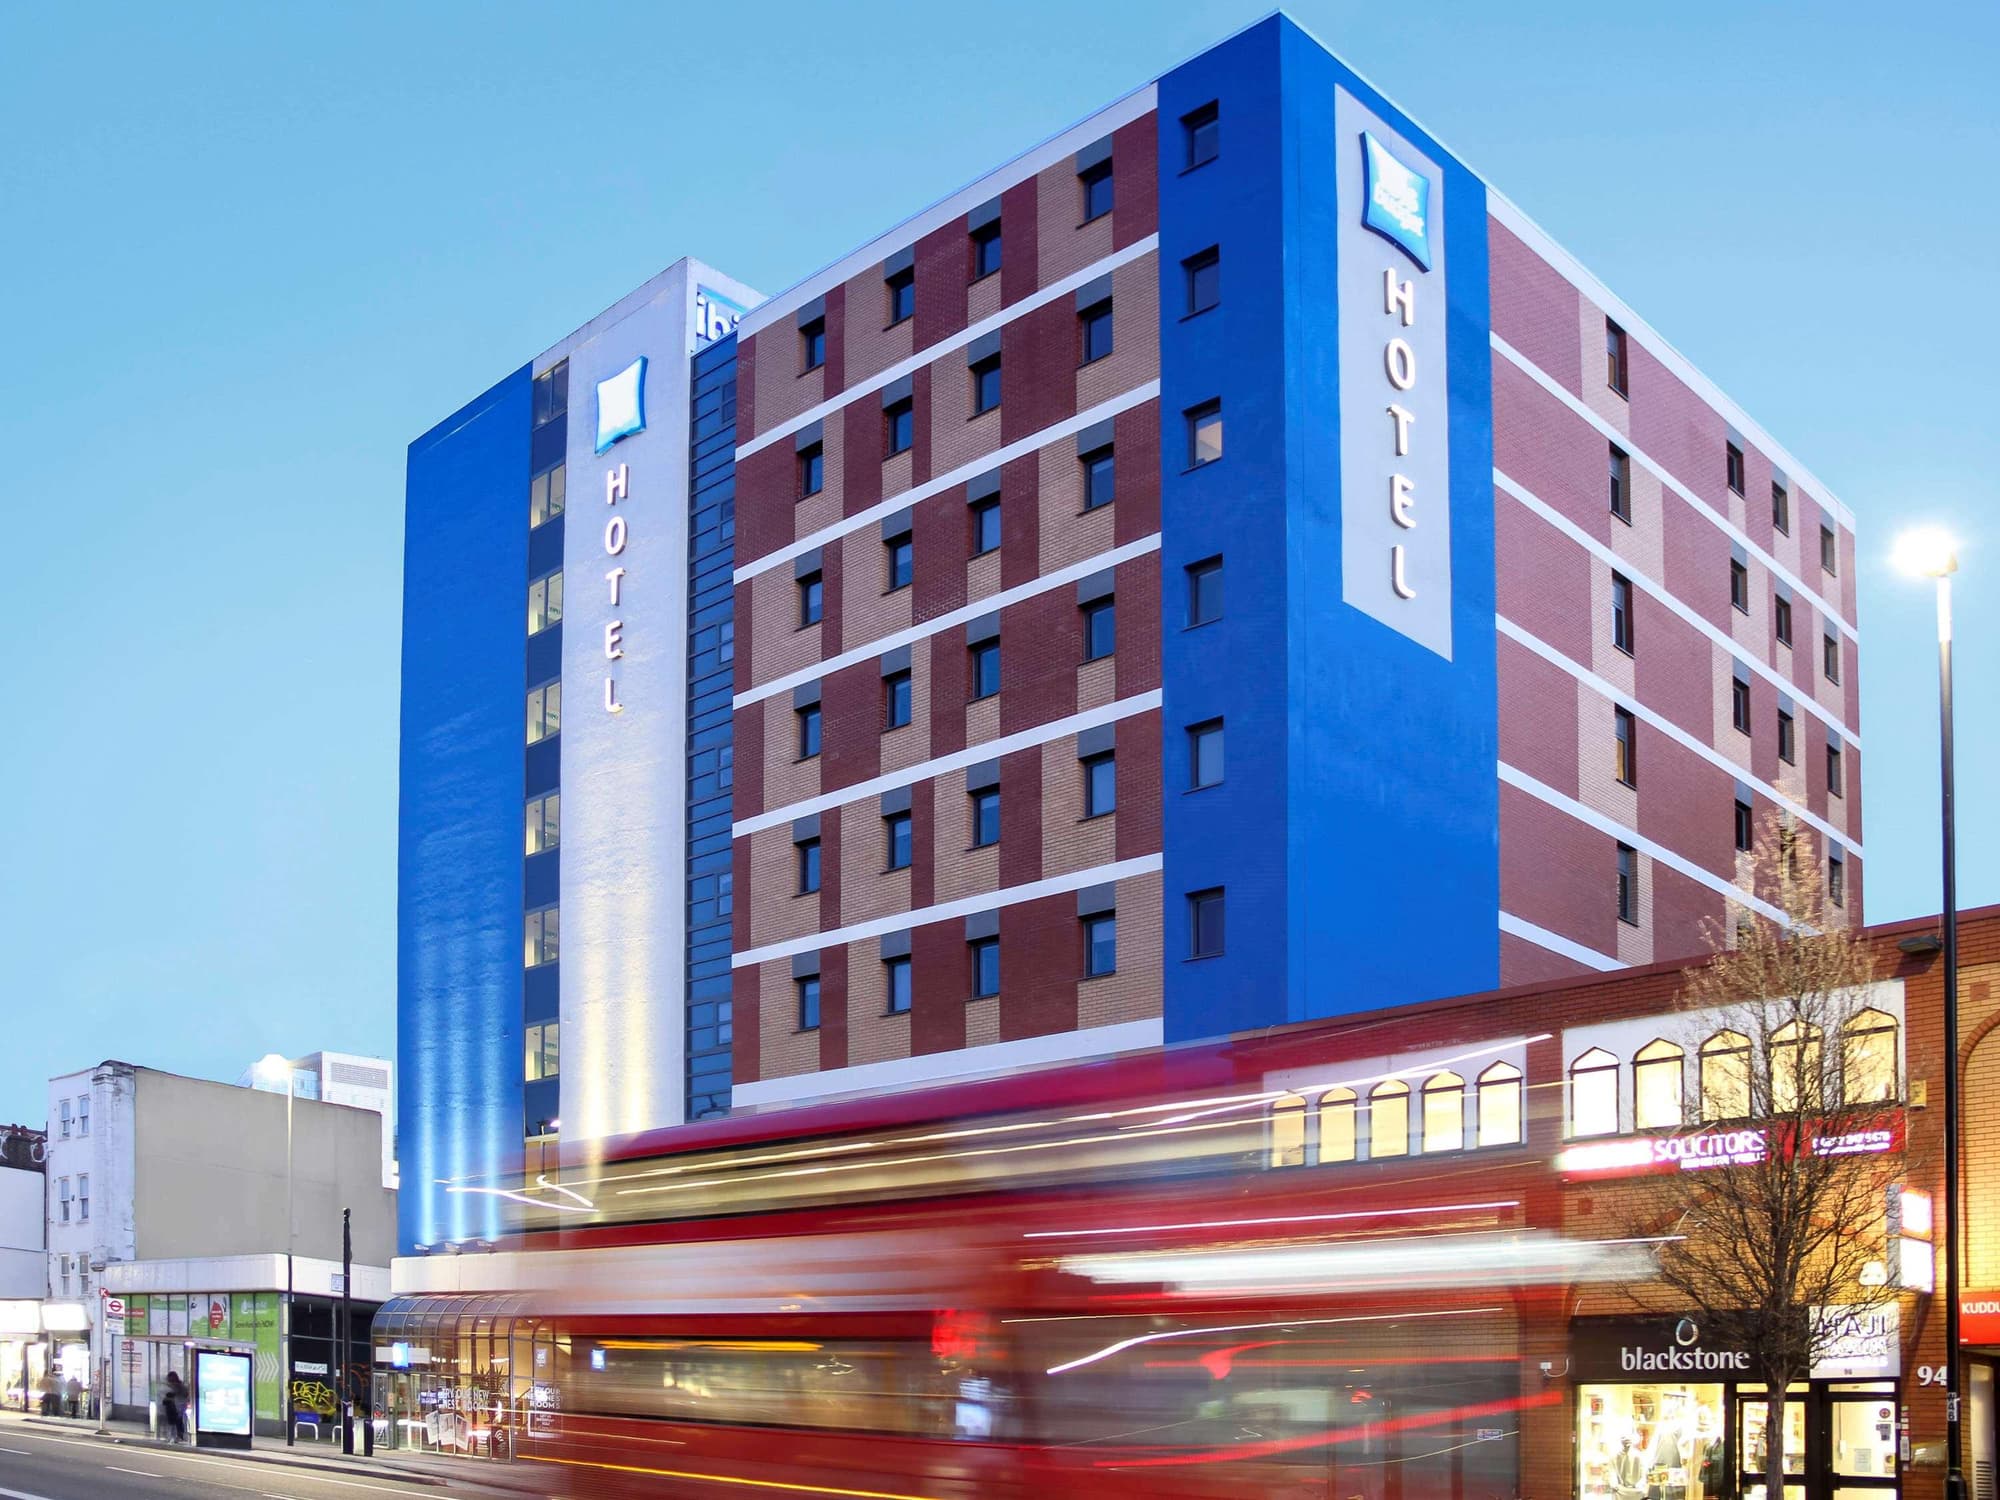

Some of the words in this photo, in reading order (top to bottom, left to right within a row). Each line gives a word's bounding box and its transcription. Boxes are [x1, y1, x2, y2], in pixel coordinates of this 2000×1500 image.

[697, 295, 739, 340] ib
[1385, 268, 1416, 599] HOTEL
[605, 463, 628, 713] HOTEL
[1654, 1130, 1766, 1161] SOLICITORS
[1621, 1346, 1749, 1370] blackstone
[1917, 1365, 1947, 1386] 94
